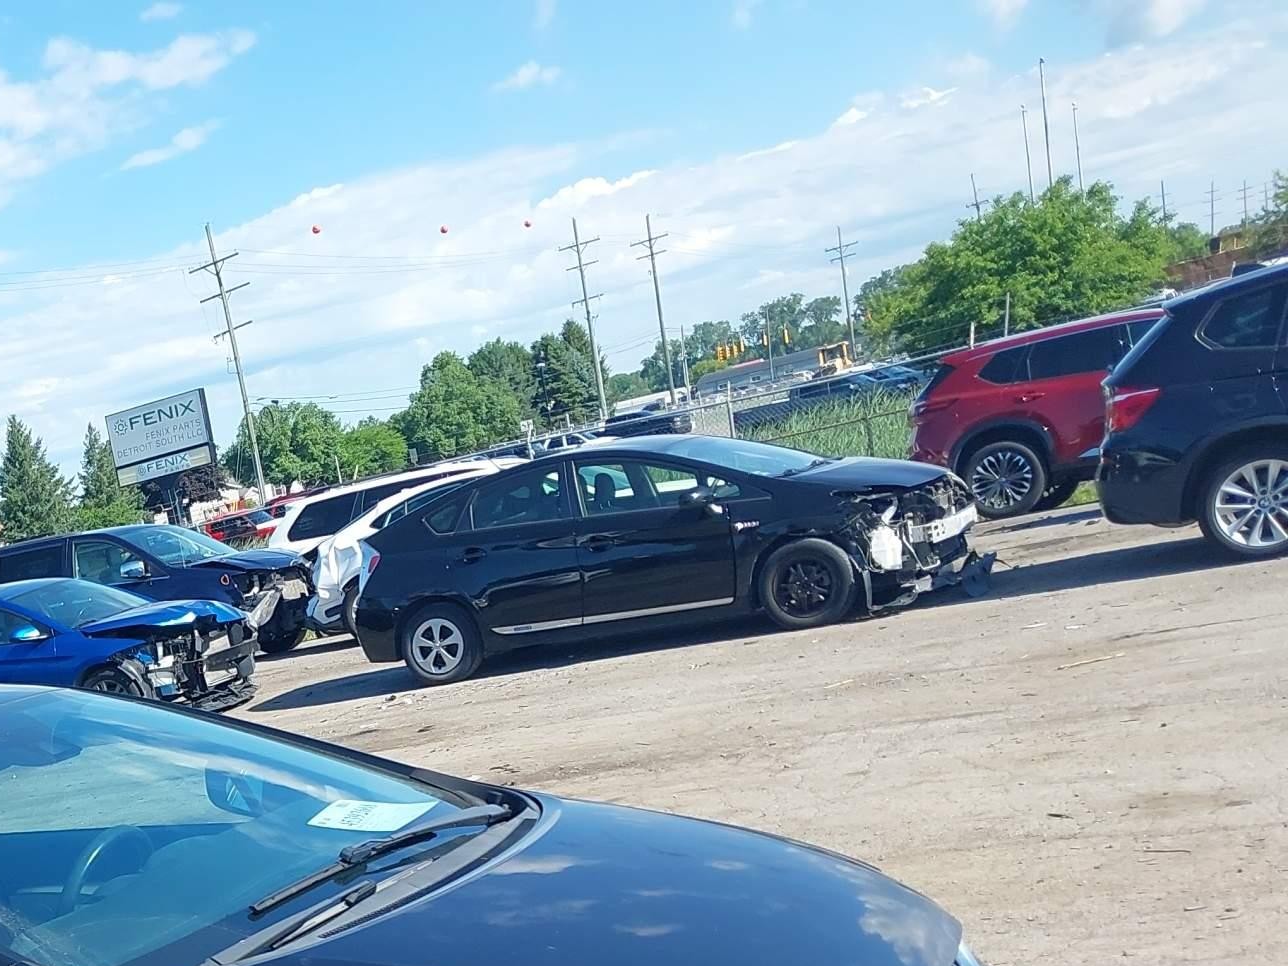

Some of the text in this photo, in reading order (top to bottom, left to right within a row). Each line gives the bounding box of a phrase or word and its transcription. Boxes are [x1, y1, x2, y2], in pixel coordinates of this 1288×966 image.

[129, 400, 196, 430] FENIX
[145, 418, 201, 440] FENIX PARTS
[117, 429, 203, 458] DETROIT SOUTH LLC
[146, 453, 189, 473] FENIX
